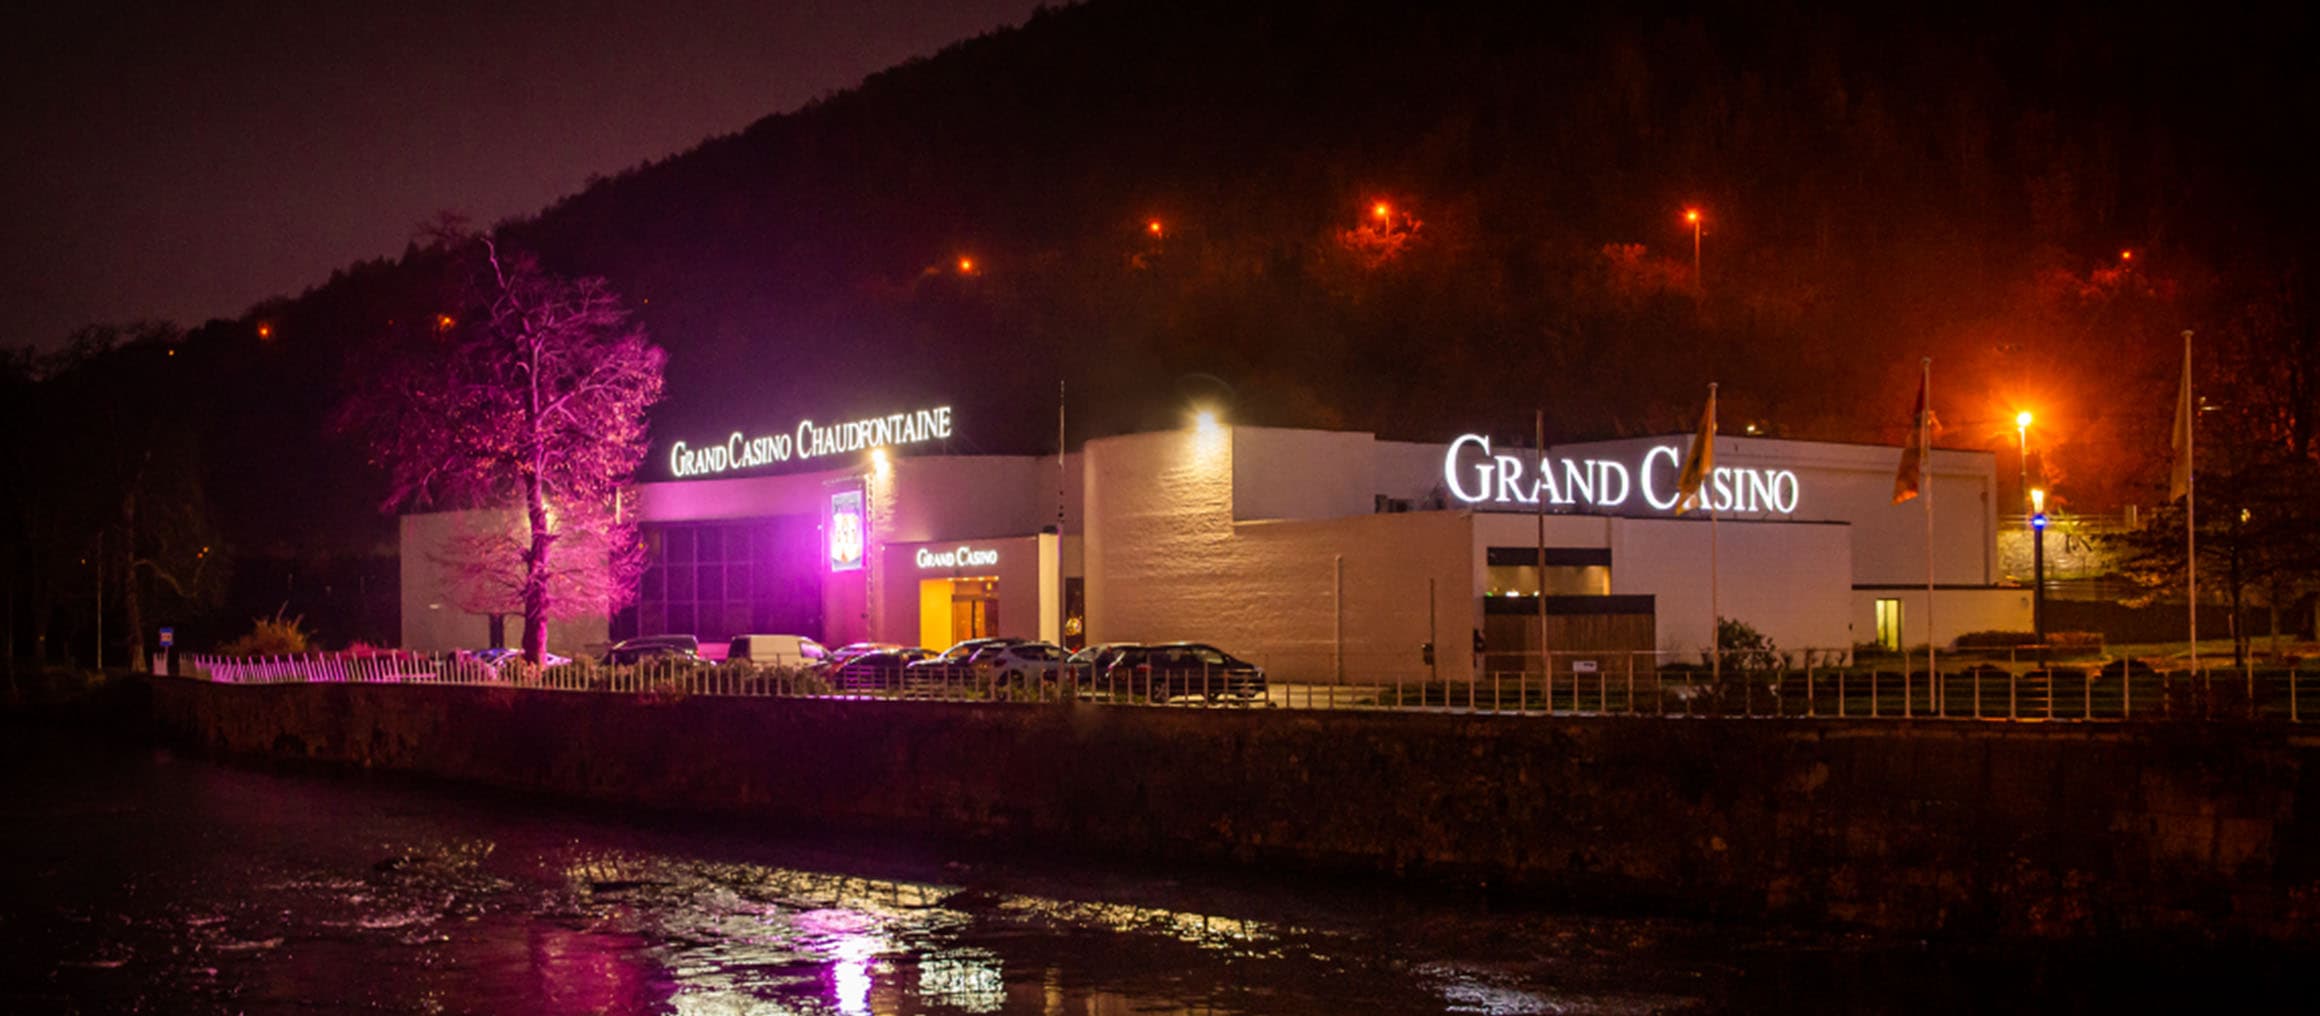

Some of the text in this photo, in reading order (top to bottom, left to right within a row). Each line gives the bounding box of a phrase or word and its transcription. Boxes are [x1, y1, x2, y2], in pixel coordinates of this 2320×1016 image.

[671, 406, 951, 477] GRAND CASINO CHAUDFONTAINE
[1444, 432, 1630, 504] GRAND
